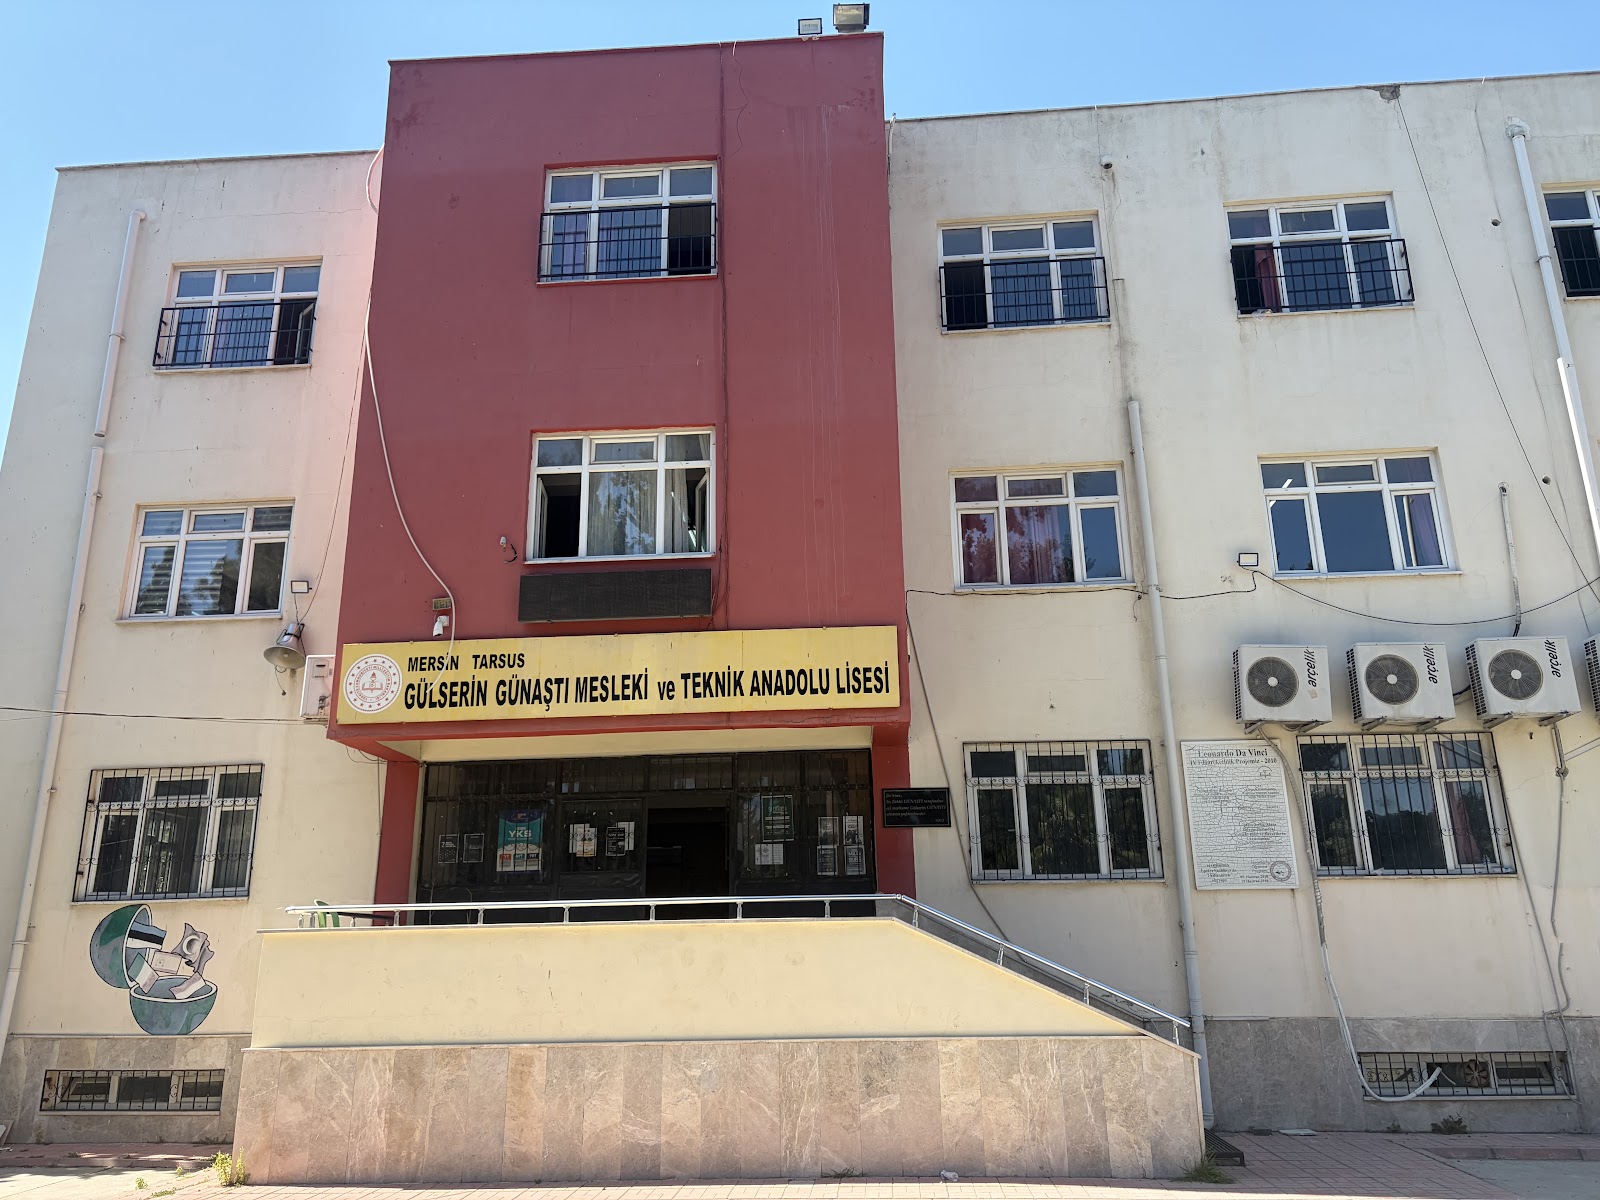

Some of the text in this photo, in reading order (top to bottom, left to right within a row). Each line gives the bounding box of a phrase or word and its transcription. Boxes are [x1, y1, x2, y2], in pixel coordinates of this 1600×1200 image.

[407, 652, 525, 672] MERSİN TARSUS
[1304, 649, 1319, 688] arçelik
[1422, 645, 1438, 684] arçelik
[1545, 639, 1561, 678] arçelik
[404, 660, 890, 712] GÜLSERİN GÜNAŞTI MESLEKİ ve TEKNİK ANADOLU LİSESİ
[1198, 748, 1268, 757] Leonardo Da Vinci
[508, 830, 532, 838] YKS
